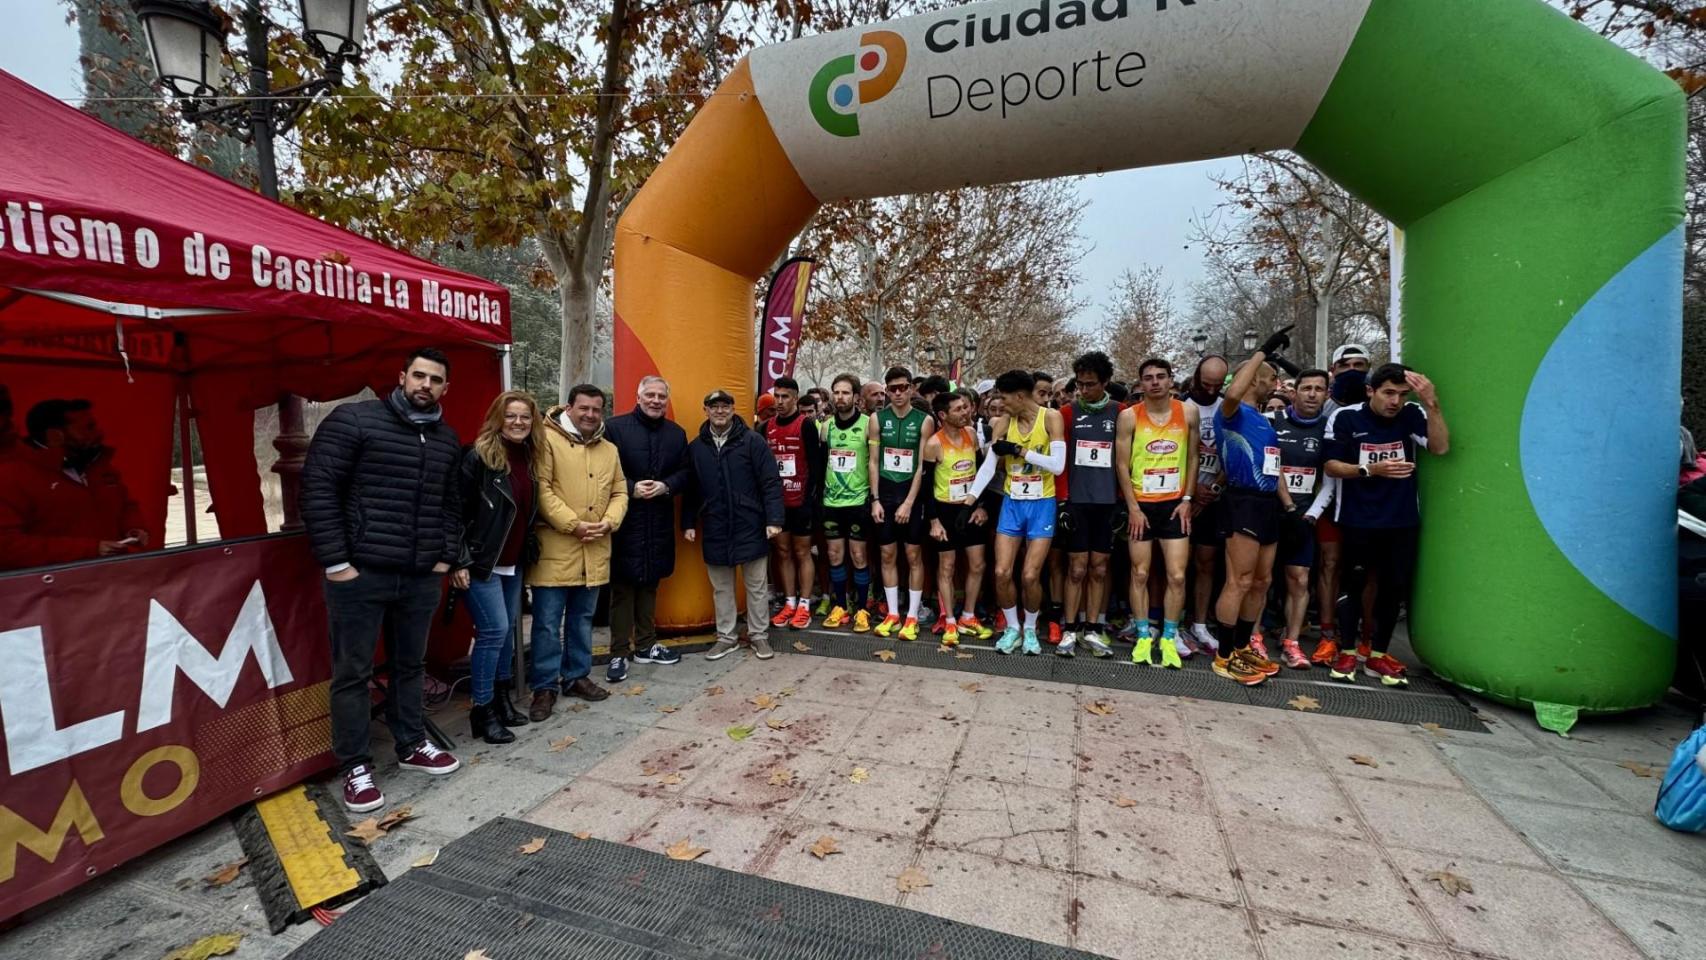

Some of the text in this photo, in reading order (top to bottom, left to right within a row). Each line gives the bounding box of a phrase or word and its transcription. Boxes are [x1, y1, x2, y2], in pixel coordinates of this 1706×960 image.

[924, 0, 1128, 53] Ciudad
[927, 50, 1146, 119] Deporte
[183, 231, 231, 281] de
[251, 244, 410, 310] Castilla-La
[421, 278, 502, 325] Mancha
[1090, 448, 1098, 460] 8
[778, 461, 784, 471] 6
[838, 456, 846, 467] 17
[893, 455, 901, 467] 3
[1158, 475, 1165, 487] 7
[1289, 474, 1304, 487] 13
[1022, 482, 1030, 494] 2
